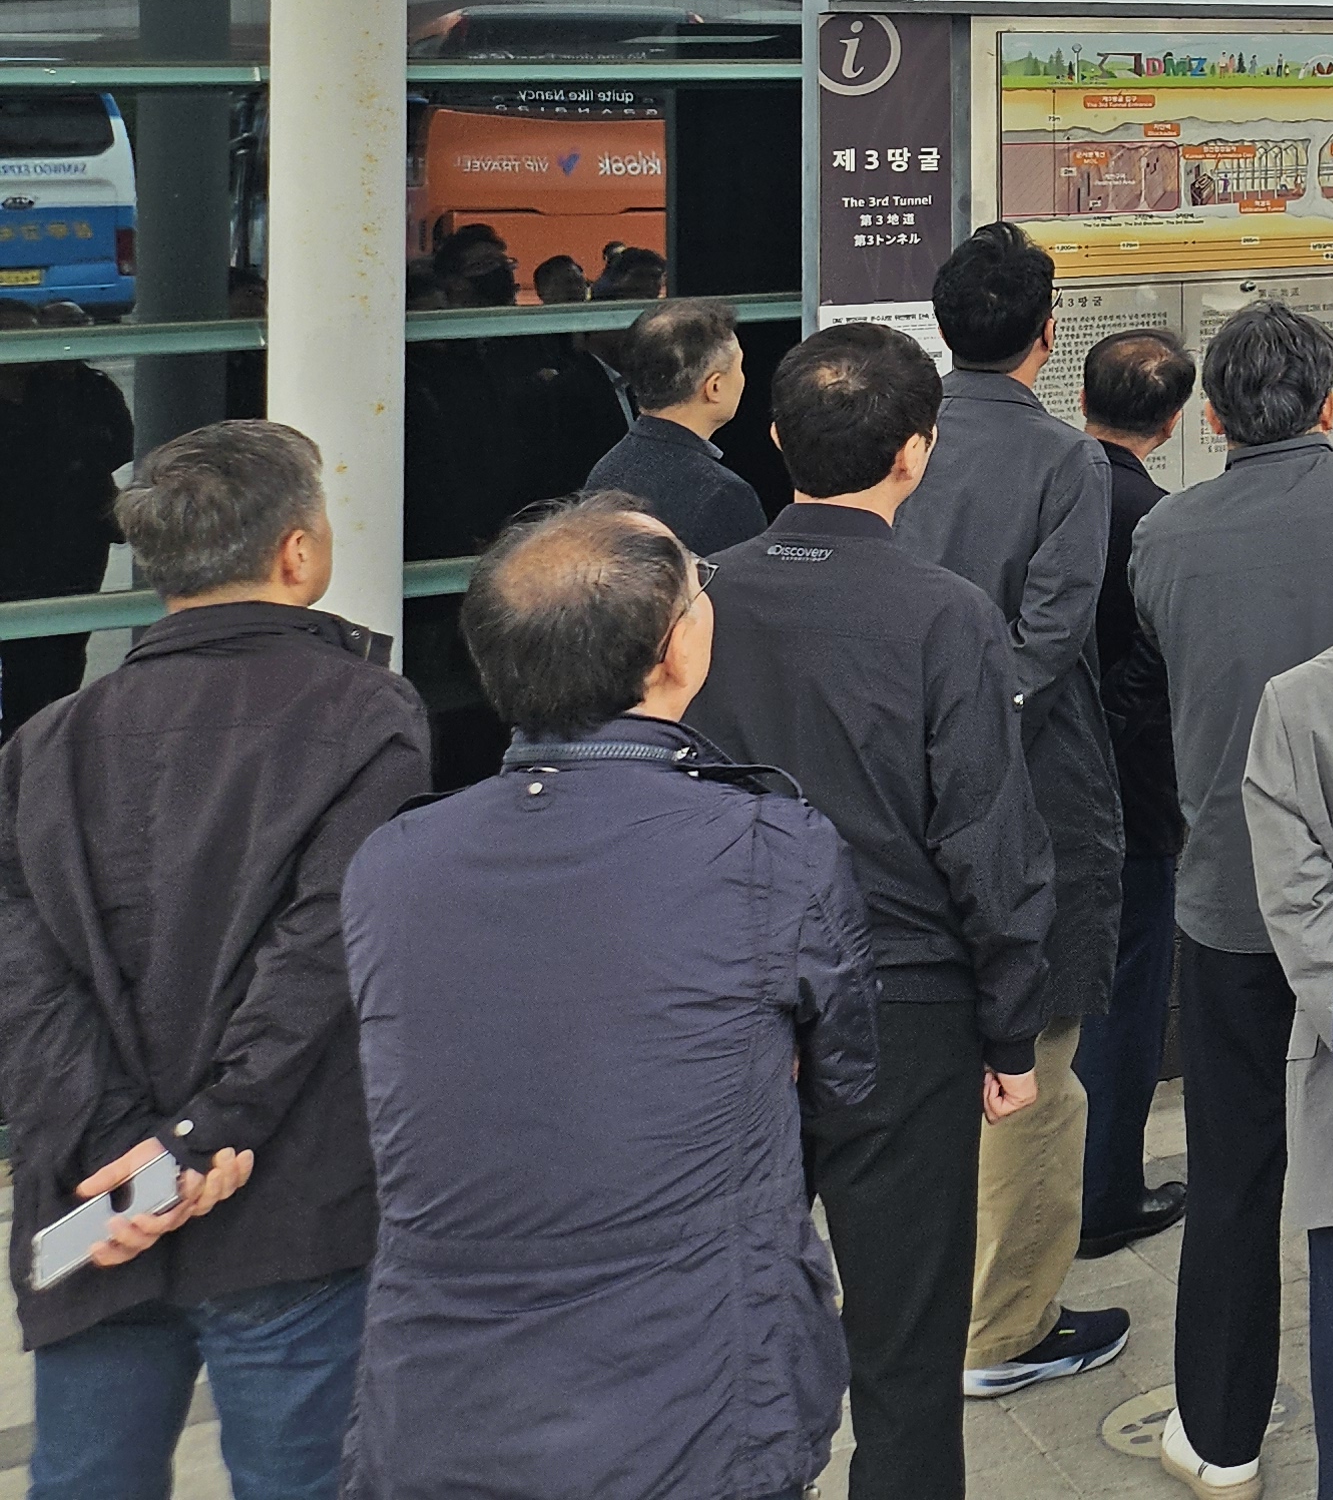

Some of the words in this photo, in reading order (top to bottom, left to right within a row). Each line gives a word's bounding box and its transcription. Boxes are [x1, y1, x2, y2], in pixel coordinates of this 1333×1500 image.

[1146, 56, 1207, 77] DMZ
[842, 196, 865, 208] The
[868, 195, 889, 207] 3rd
[893, 194, 932, 206] Tunnel
[853, 232, 921, 248] 第3トンネル
[767, 544, 834, 561] Discovery
